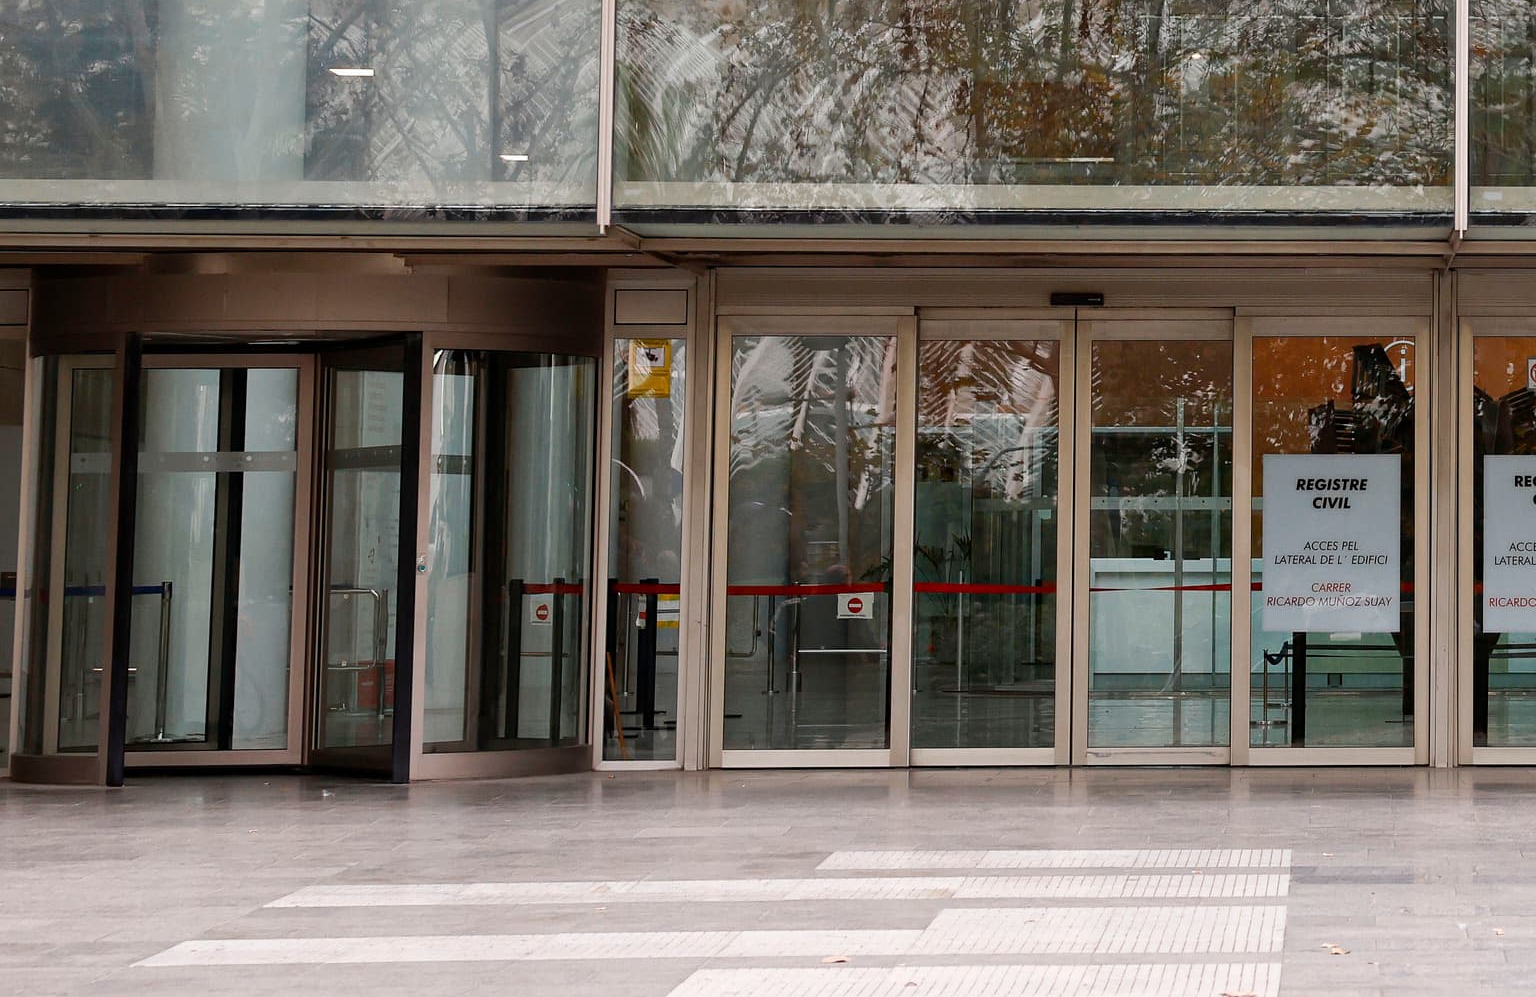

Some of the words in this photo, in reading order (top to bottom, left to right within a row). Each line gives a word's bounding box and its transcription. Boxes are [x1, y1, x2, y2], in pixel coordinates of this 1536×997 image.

[1296, 478, 1368, 491] REGISTRE
[1312, 497, 1351, 509] CIVIL
[1303, 541, 1339, 551] ACCES
[1341, 541, 1359, 551] PEL
[1274, 555, 1317, 565] LATERAL
[1320, 555, 1336, 565] DE
[1351, 555, 1388, 565] EDIFICI
[1494, 556, 1536, 566] LATERAL
[1311, 583, 1351, 593] CARRER
[1266, 597, 1315, 607] RICARDO
[1318, 594, 1361, 607] MUÑOZ
[1364, 597, 1393, 607] SUAY
